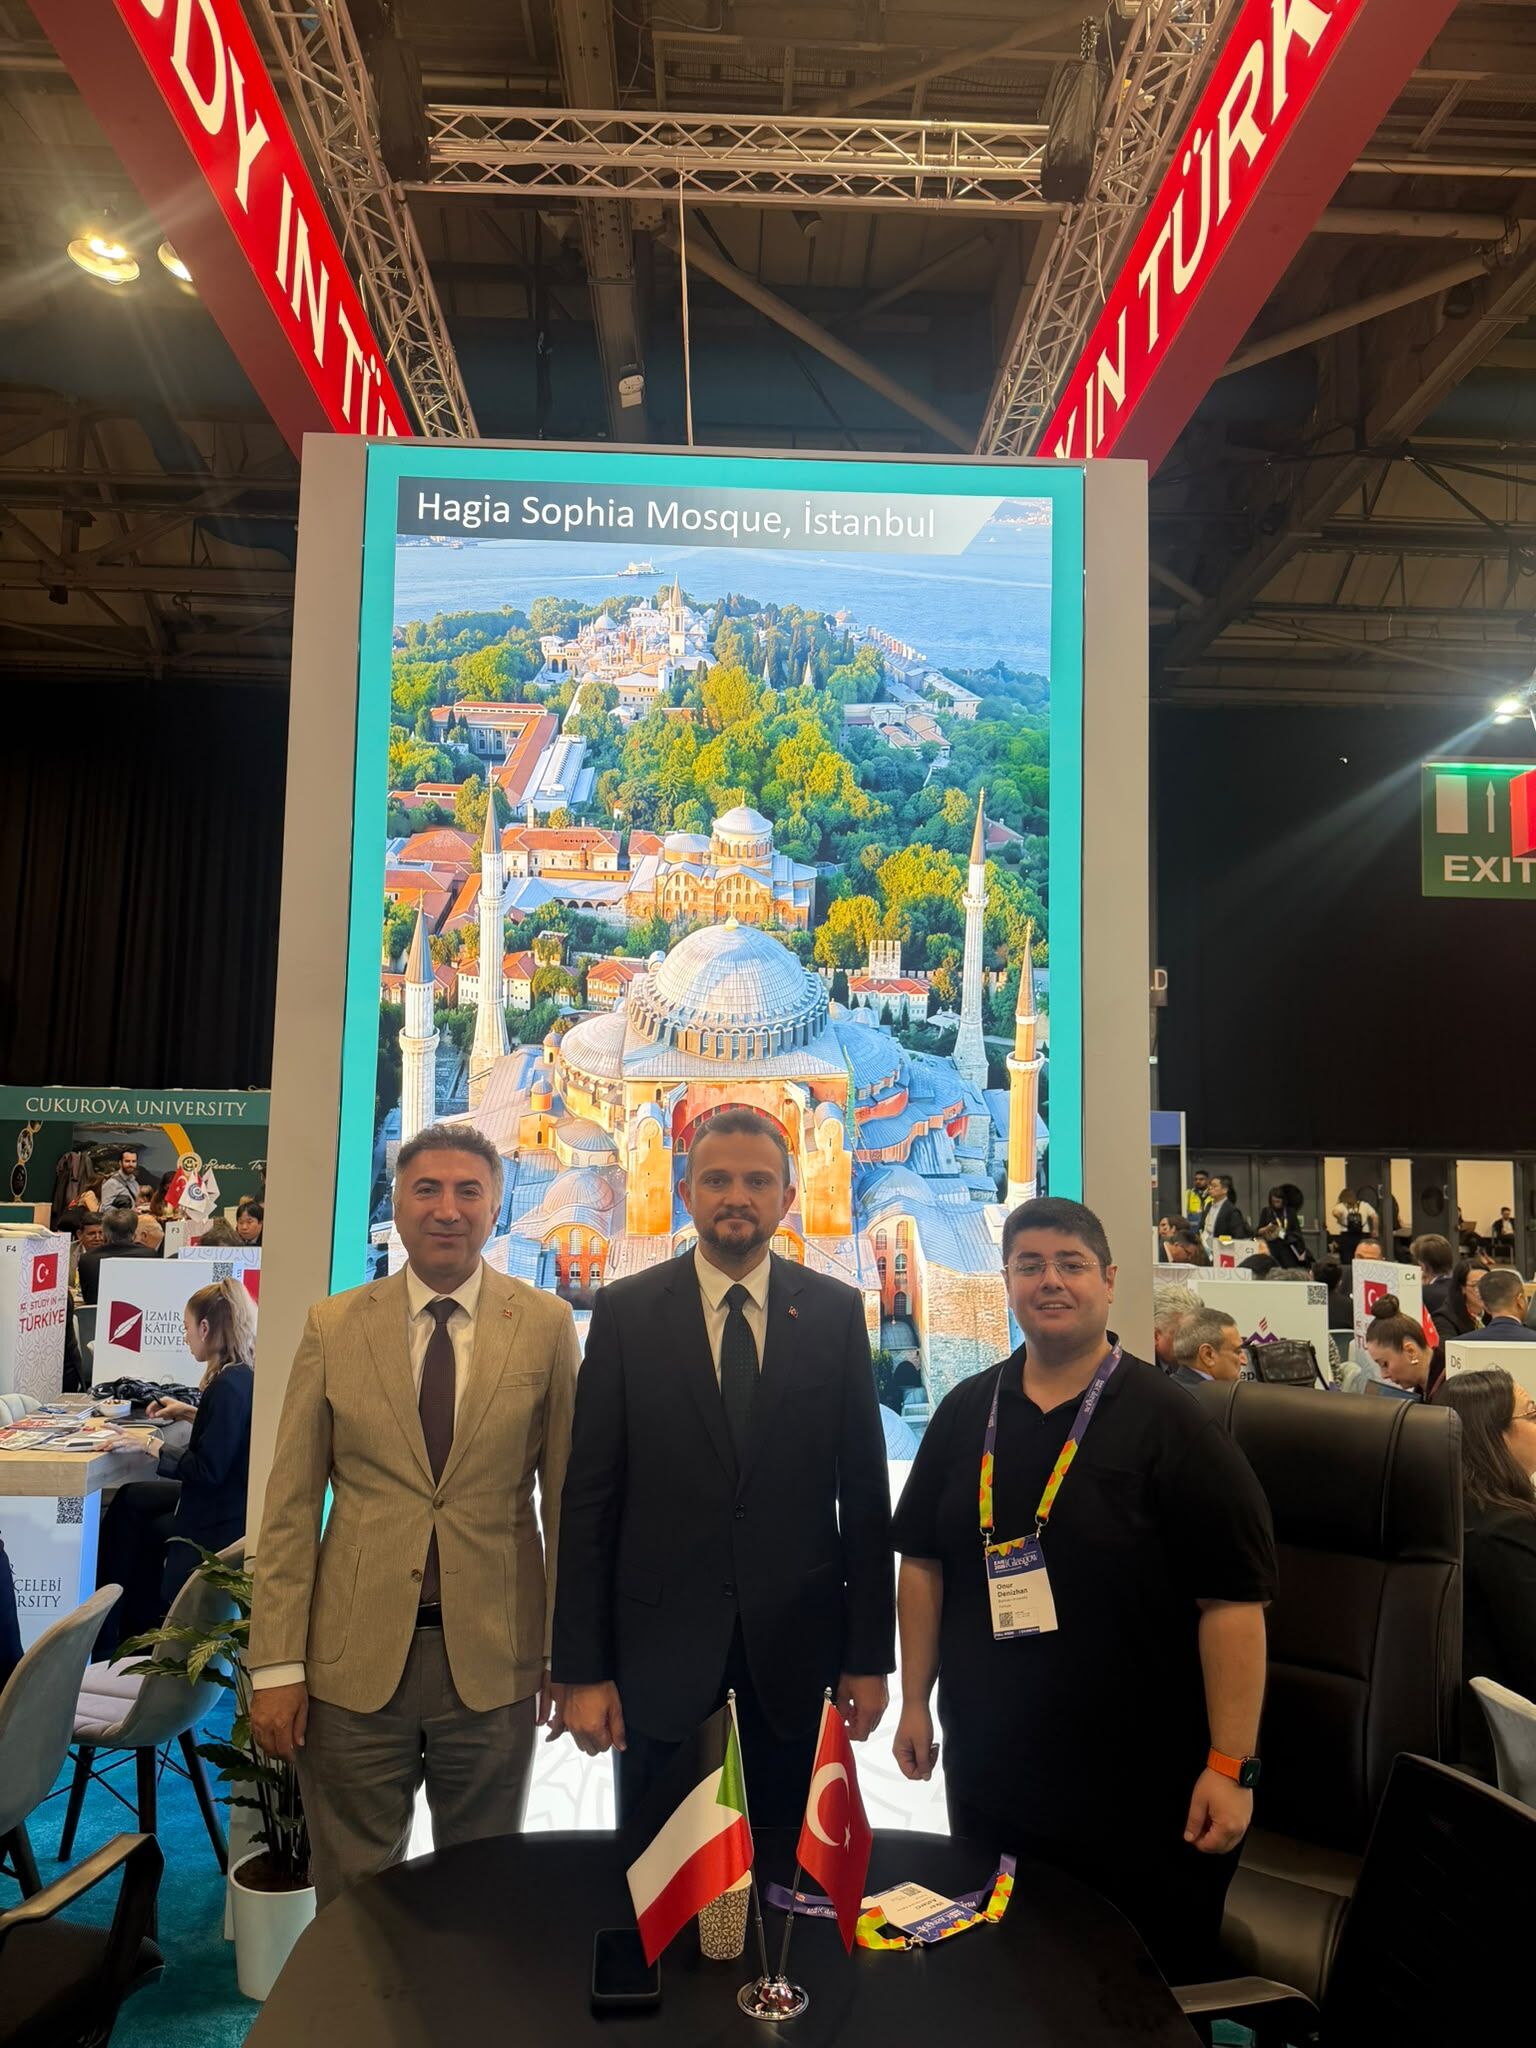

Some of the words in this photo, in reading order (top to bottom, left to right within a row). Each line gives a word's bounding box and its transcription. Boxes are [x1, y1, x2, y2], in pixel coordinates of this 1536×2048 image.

[140, 0, 270, 214] DY
[276, 172, 330, 367] IN
[1086, 305, 1128, 458] IN
[1136, 0, 1340, 354] TÜRK
[418, 491, 510, 529] Hagia
[521, 496, 635, 532] Sophia
[647, 500, 792, 539] Mosque,
[804, 500, 935, 538] İstanbul
[1443, 855, 1536, 883] EXIT
[25, 1097, 130, 1115] CUKUROVA
[136, 1100, 248, 1117] UNIVERSITY
[1404, 1272, 1416, 1281] C4
[30, 1299, 50, 1311] STUDY
[50, 1298, 57, 1307] IN
[20, 1308, 66, 1333] TÜRKİYE
[145, 1309, 181, 1321] İZMİR
[144, 1336, 186, 1346] UNIVE
[1450, 1355, 1462, 1370] D6
[13, 1577, 62, 1595] ÇELEBİ
[997, 1587, 1029, 1598] Denizhan
[17, 1595, 62, 1608] RSITY
